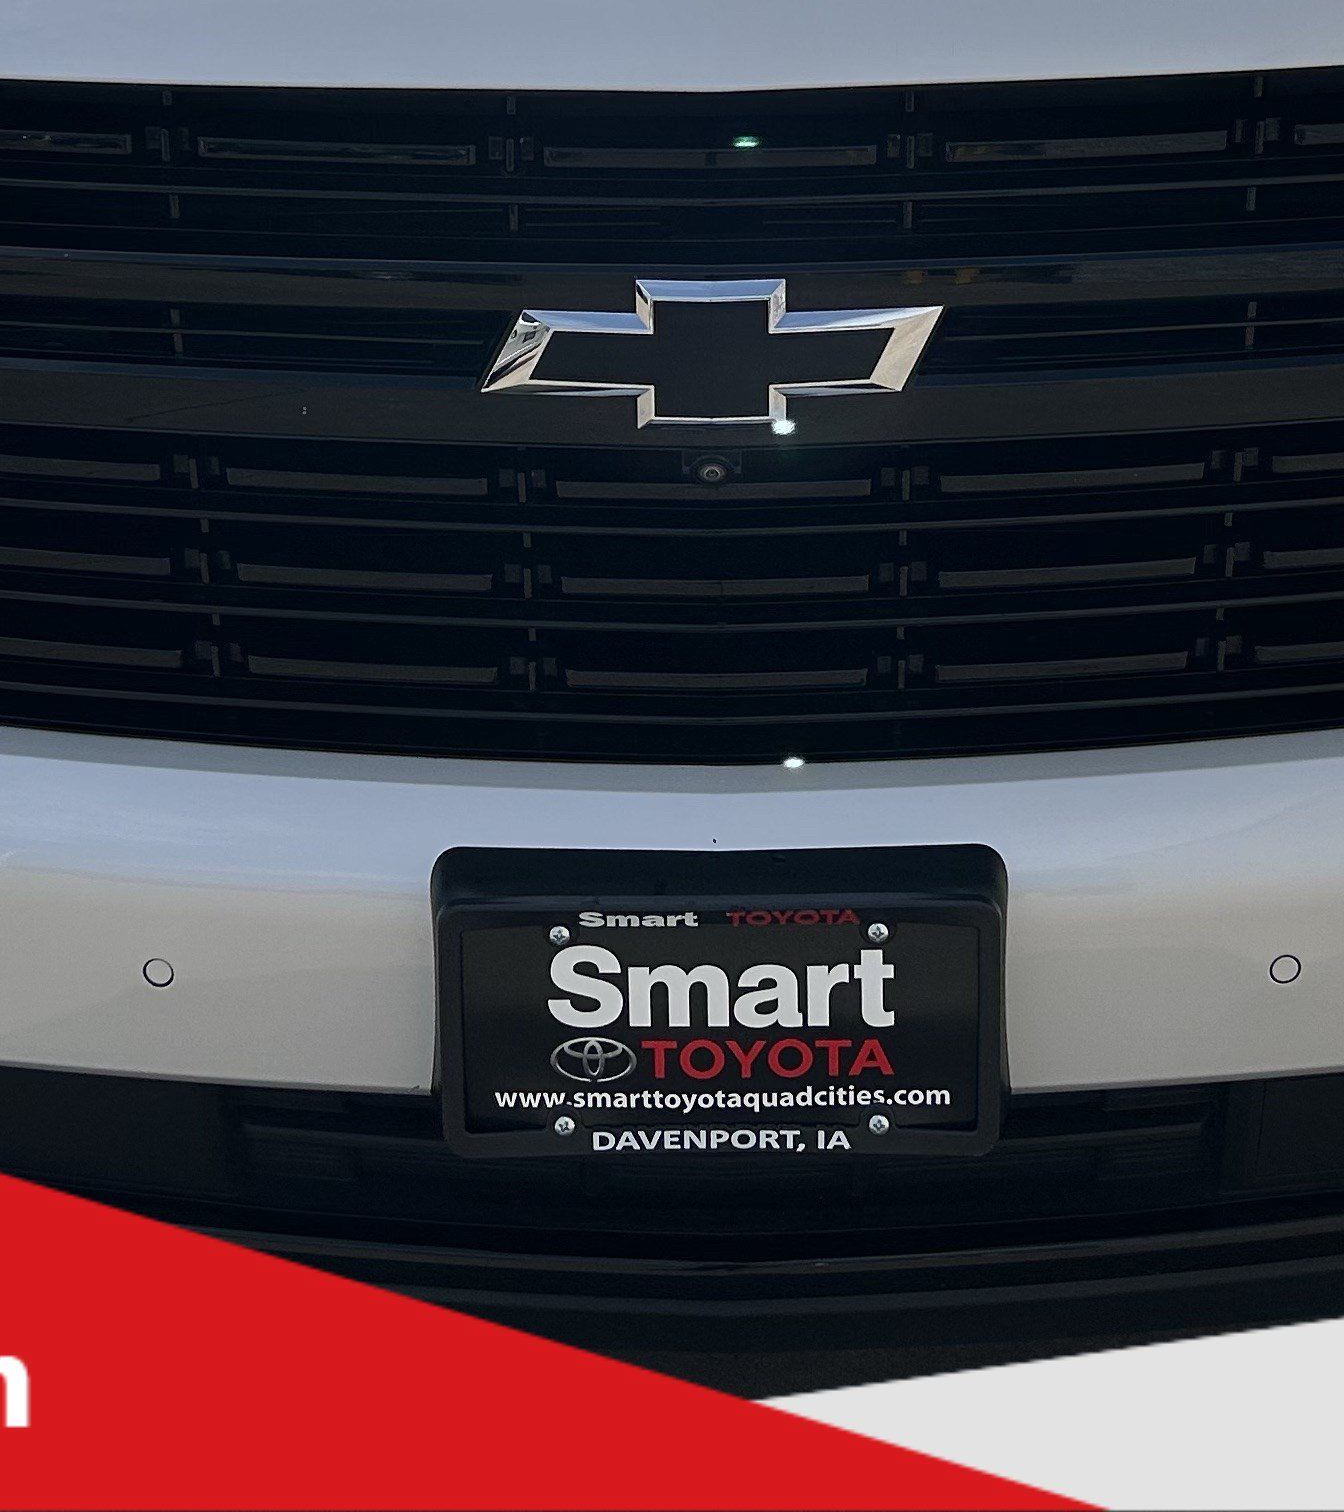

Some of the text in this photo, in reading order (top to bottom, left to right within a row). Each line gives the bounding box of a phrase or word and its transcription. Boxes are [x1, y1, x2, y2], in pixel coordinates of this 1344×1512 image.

[578, 909, 860, 928] Smart TOYOTA
[547, 944, 895, 1029] Smart
[641, 1038, 894, 1080] TOYOTA
[495, 1084, 951, 1113] www.smarttoyotaquadcities.com
[592, 1129, 852, 1152] DAVENPORT, IA
